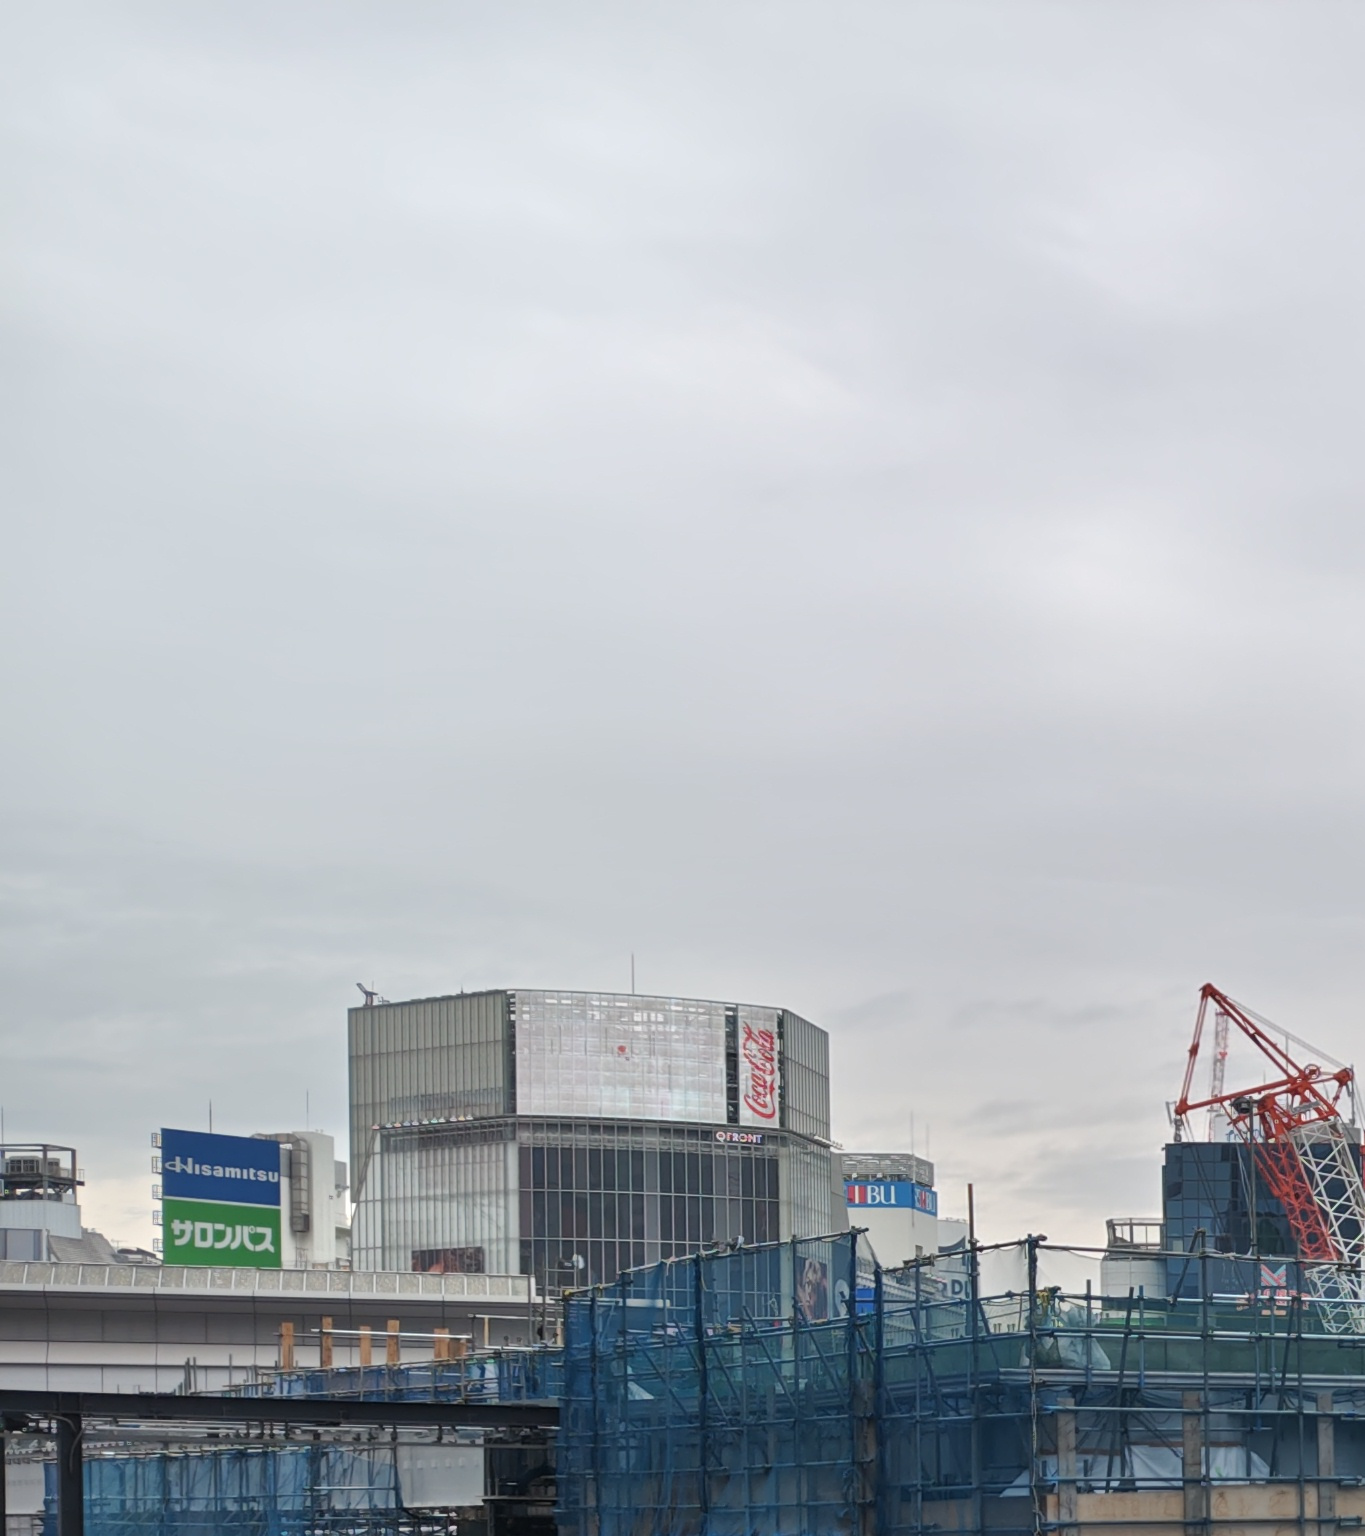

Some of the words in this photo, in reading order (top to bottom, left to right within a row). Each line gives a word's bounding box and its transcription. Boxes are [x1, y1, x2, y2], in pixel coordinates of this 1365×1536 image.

[716, 1131, 762, 1144] QFRONT
[164, 1156, 279, 1183] Hisamitsu
[171, 1219, 275, 1253] サロンパス
